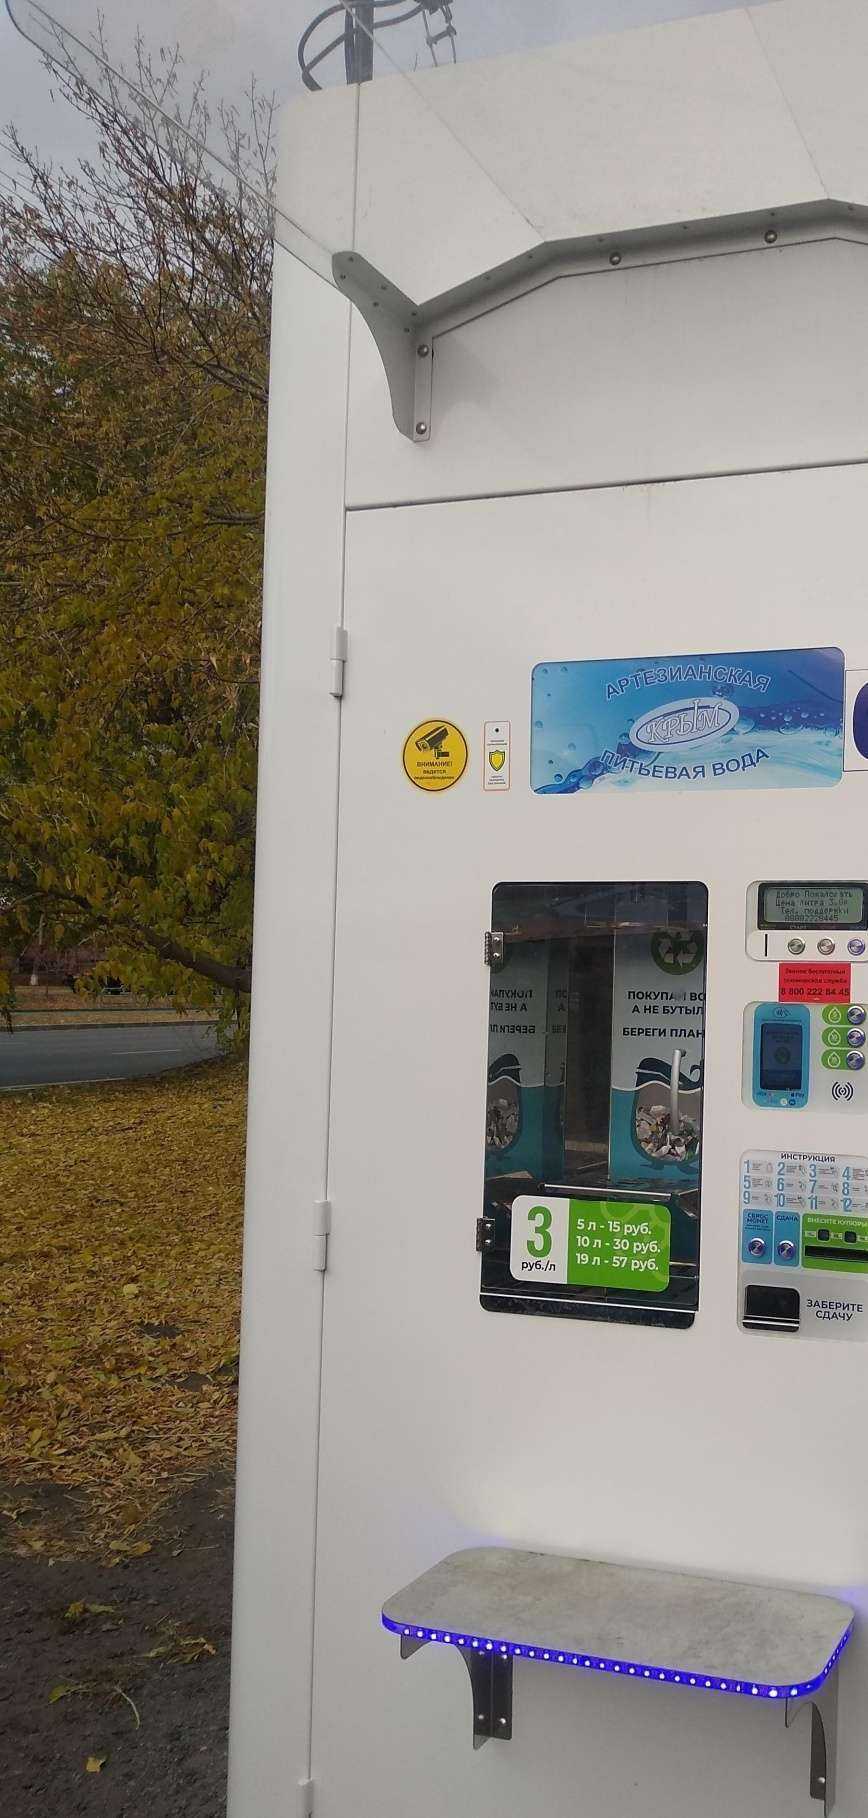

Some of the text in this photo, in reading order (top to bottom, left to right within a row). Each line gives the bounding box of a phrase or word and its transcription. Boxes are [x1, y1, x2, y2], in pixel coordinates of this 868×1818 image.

[605, 664, 772, 701] АРТЕЗИАНСКАЯ
[646, 699, 723, 743] КРЫМ
[600, 747, 770, 780] ПИТЬЕВАЯ ВОДА
[775, 899, 796, 907] Цена
[806, 987, 823, 996] 222
[631, 1005, 641, 1014] А
[643, 1005, 659, 1014] НЕ
[622, 1027, 667, 1038] БЕРЕГИ
[780, 1153, 836, 1163] ИНСТРУКЦИЯ
[744, 1160, 751, 1174] 1
[777, 1162, 786, 1176] 2
[808, 1164, 817, 1178] 3
[842, 1167, 851, 1181] 4
[743, 1175, 752, 1190] 5
[777, 1178, 786, 1192] 6
[808, 1180, 818, 1194] 7
[842, 1182, 851, 1196] 8
[743, 1191, 751, 1205] 9
[774, 1193, 786, 1207] 10
[808, 1195, 818, 1210] 11
[840, 1198, 852, 1212] 12
[526, 1205, 553, 1258] 3
[576, 1219, 585, 1230] 5
[588, 1221, 597, 1231] л
[607, 1221, 621, 1233] 15
[623, 1222, 652, 1236] руб.
[576, 1236, 590, 1248] 10
[593, 1239, 602, 1248] л
[613, 1239, 630, 1250] 30
[633, 1240, 661, 1254] руб.
[521, 1260, 556, 1271] руб./л
[576, 1253, 589, 1265] 19
[592, 1256, 601, 1266] л
[612, 1256, 628, 1268] 57
[631, 1258, 659, 1271] руб.
[806, 1299, 863, 1312] ЗАБЕРИТЕ
[816, 1310, 853, 1321] СДАЧУ
